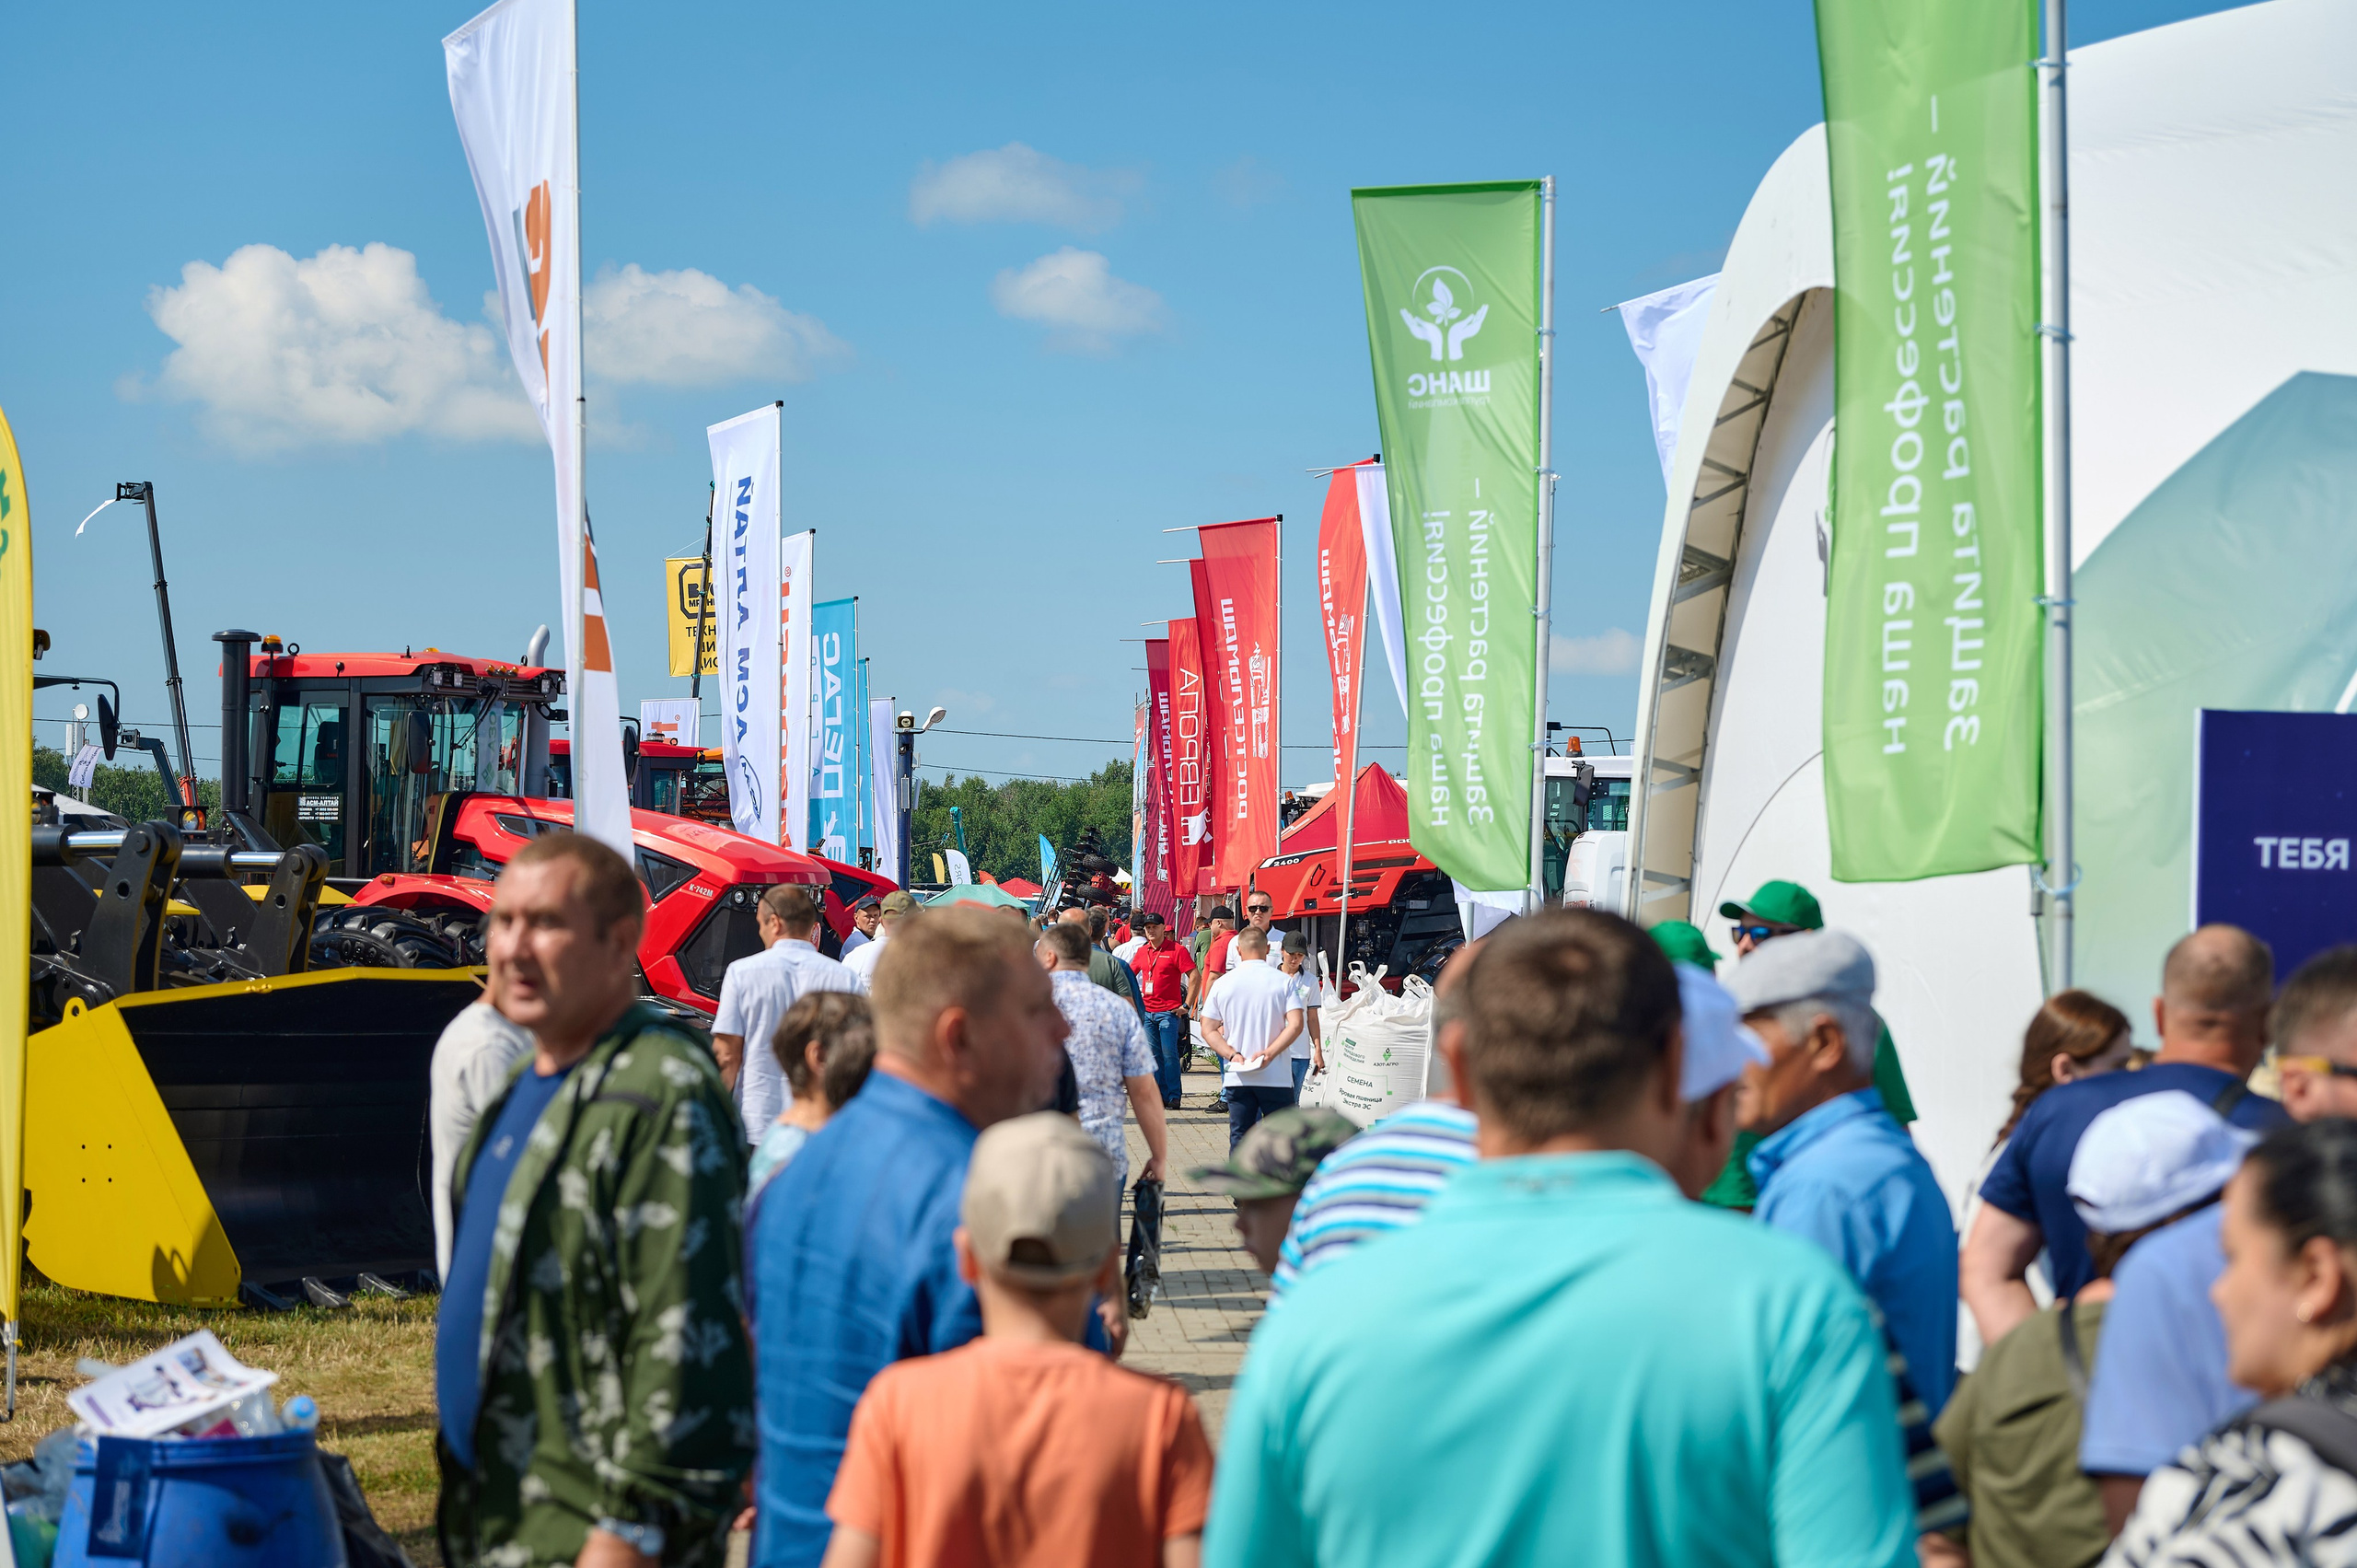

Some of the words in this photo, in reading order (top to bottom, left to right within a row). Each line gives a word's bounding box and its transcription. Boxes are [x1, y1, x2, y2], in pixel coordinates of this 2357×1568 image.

[2253, 836, 2351, 871] ТЕБЯ
[1273, 857, 1300, 867] 2400
[1346, 1075, 1374, 1088] СЕМЕНА
[1342, 1098, 1362, 1109] Экстра
